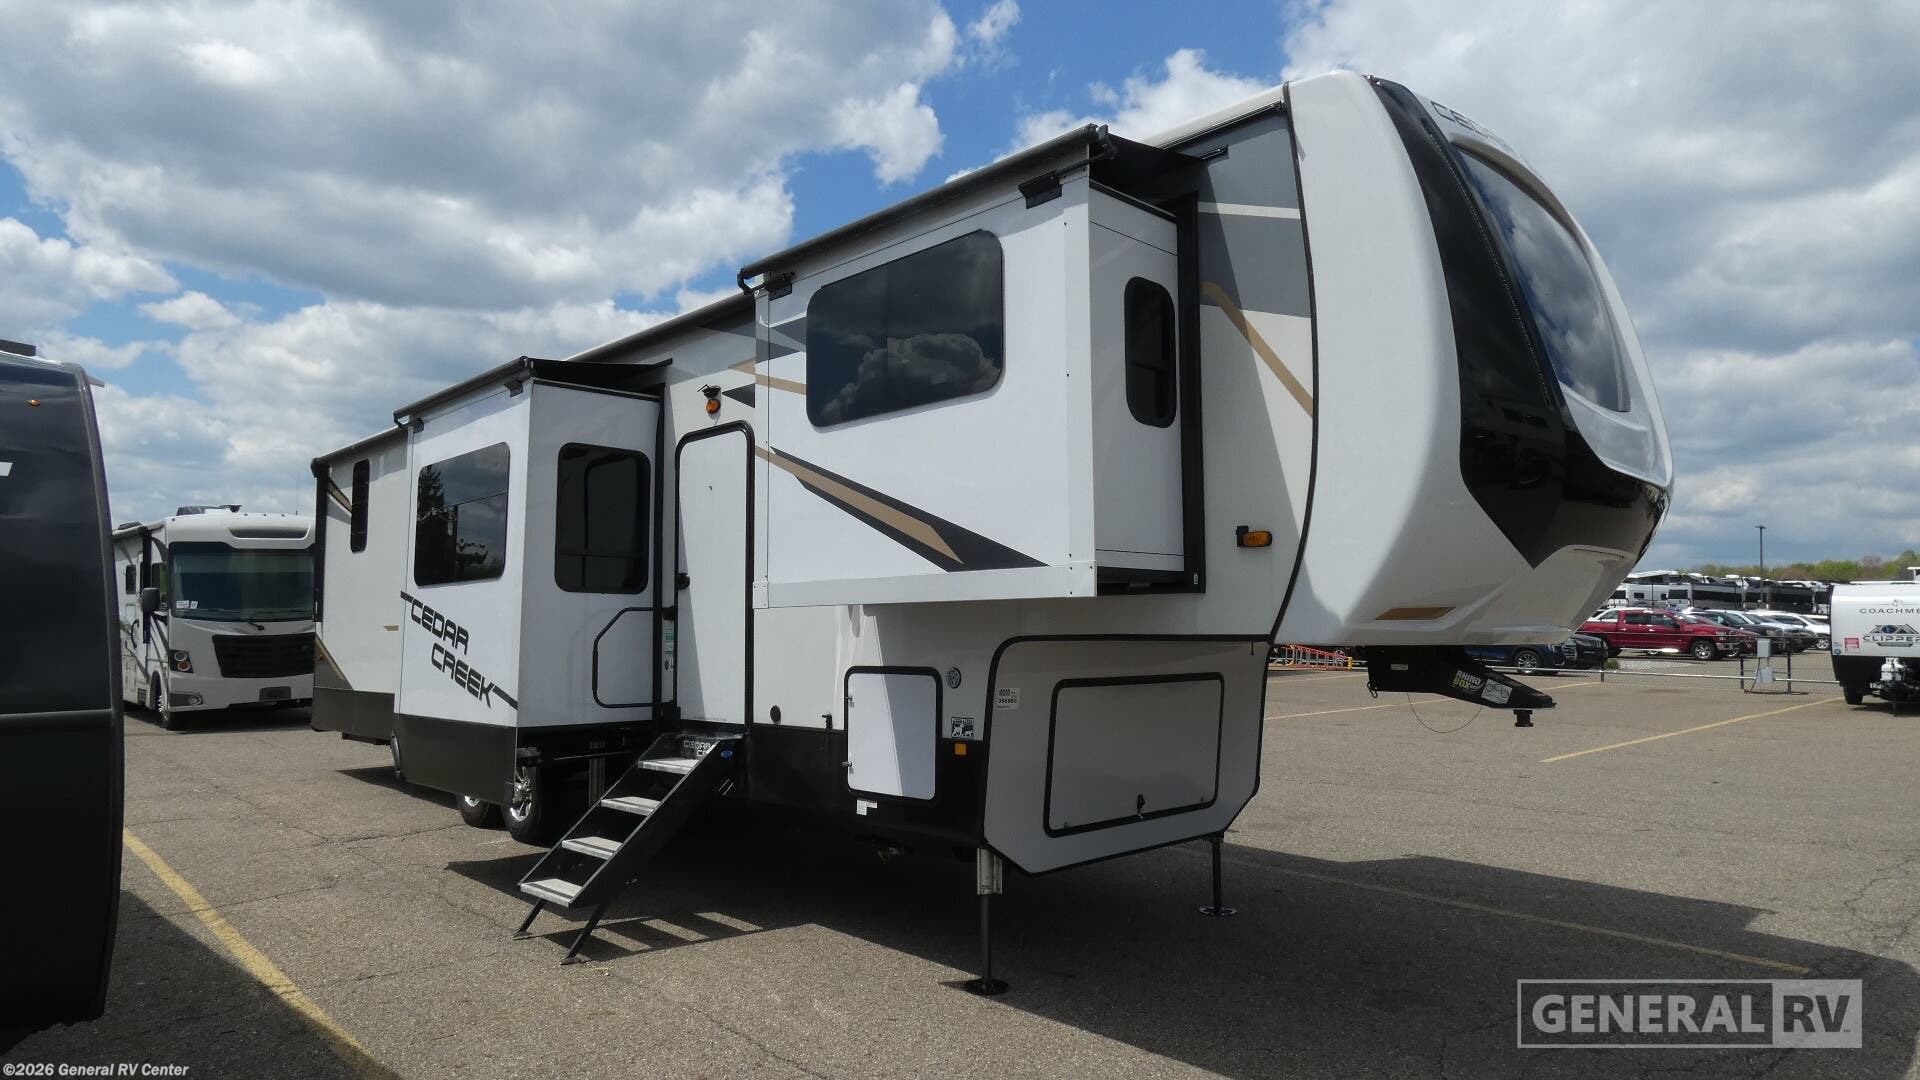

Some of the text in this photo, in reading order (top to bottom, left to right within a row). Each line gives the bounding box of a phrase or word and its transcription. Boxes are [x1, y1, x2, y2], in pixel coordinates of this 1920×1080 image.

[411, 598, 469, 655] CEDAR
[431, 642, 495, 709] CREEK
[1453, 677, 1471, 689] BOX
[1456, 670, 1481, 685] RHINO
